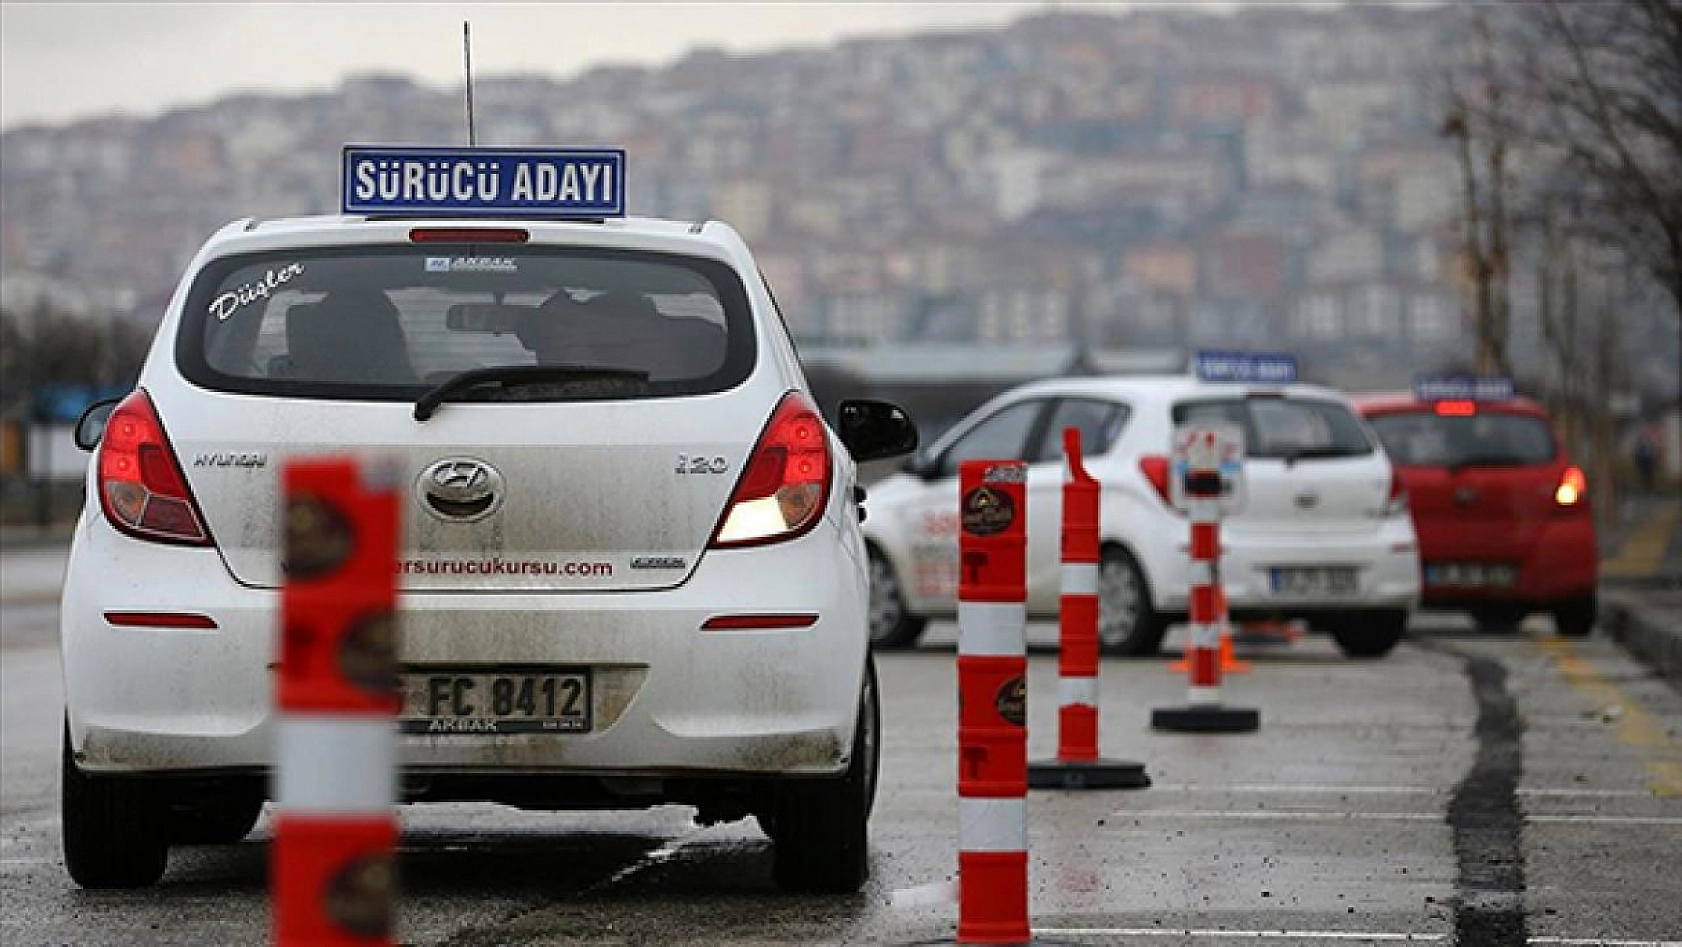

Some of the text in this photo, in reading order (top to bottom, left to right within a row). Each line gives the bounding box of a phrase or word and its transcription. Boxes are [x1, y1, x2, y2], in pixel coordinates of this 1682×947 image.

[356, 160, 612, 201] SÜRÜCÜ ADAYI
[429, 677, 582, 716] FC 8412
